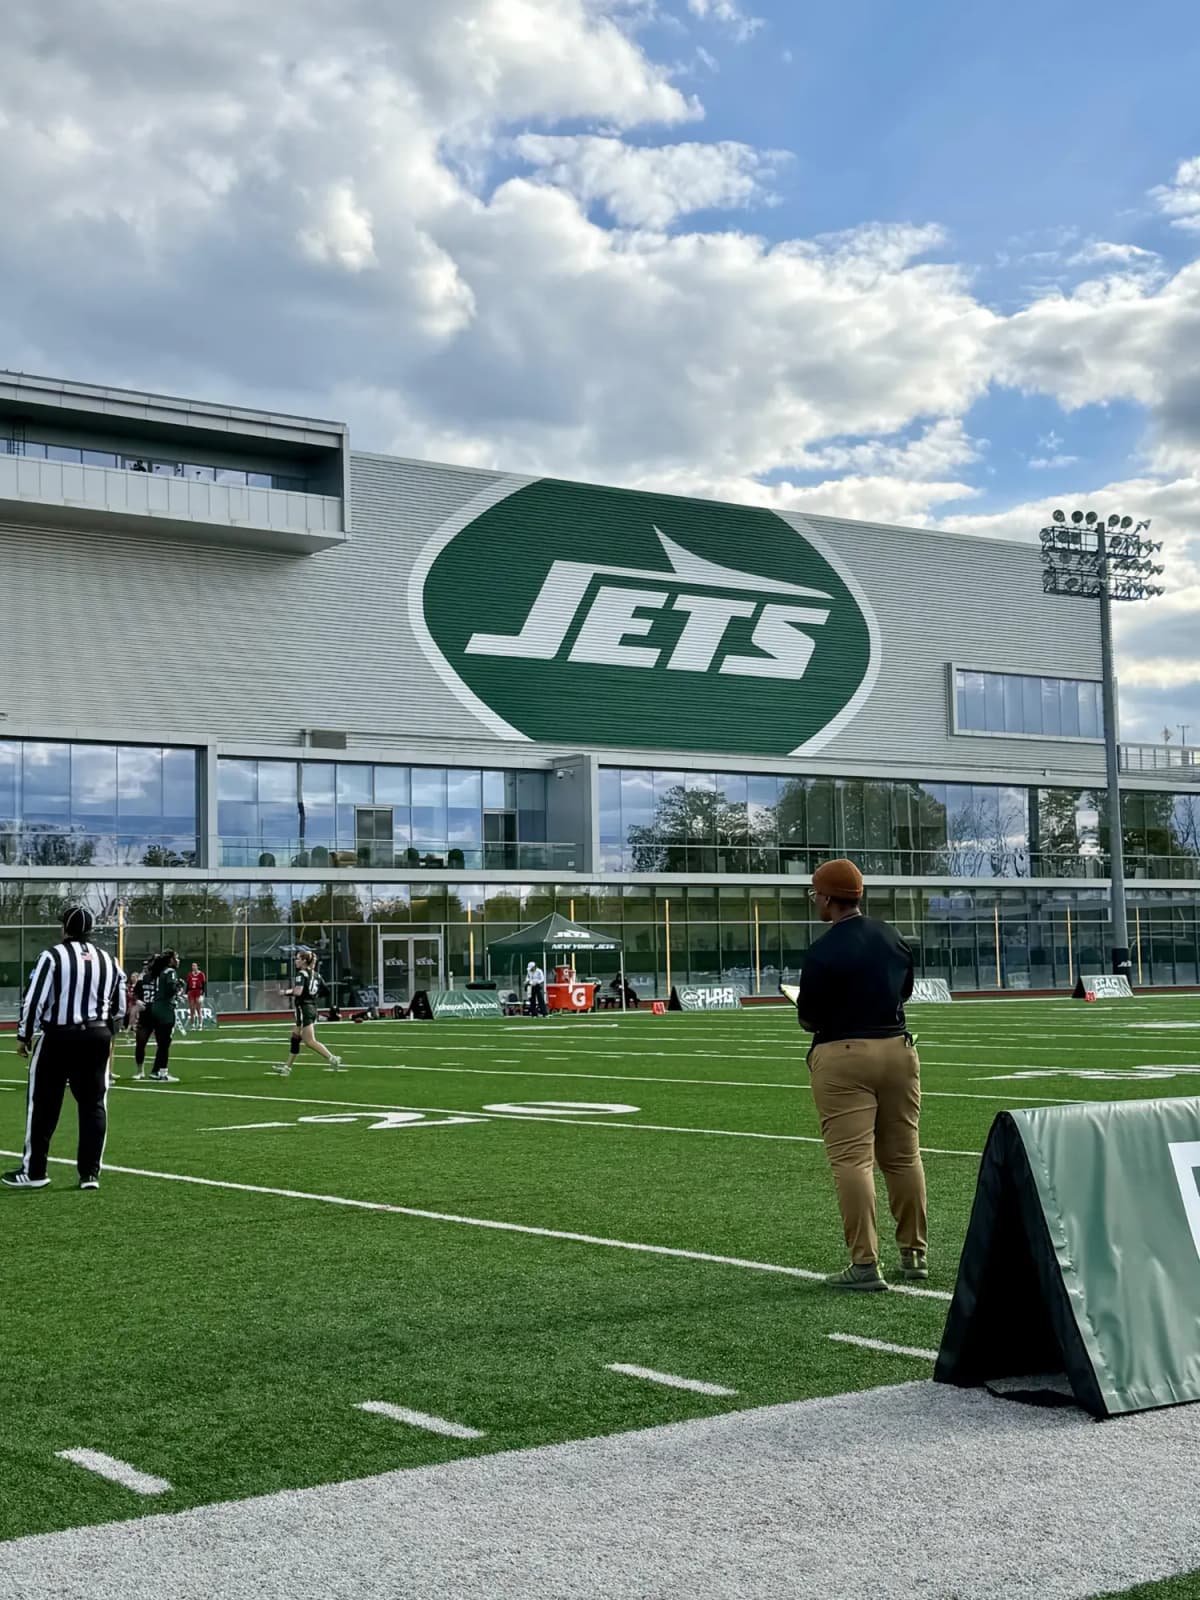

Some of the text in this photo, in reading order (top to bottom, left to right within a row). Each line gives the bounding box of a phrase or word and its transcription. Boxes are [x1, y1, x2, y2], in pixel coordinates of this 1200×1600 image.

[464, 558, 834, 680] JETS
[571, 987, 587, 1007] G
[697, 987, 734, 1007] FLAG
[297, 1101, 641, 1130] 20
